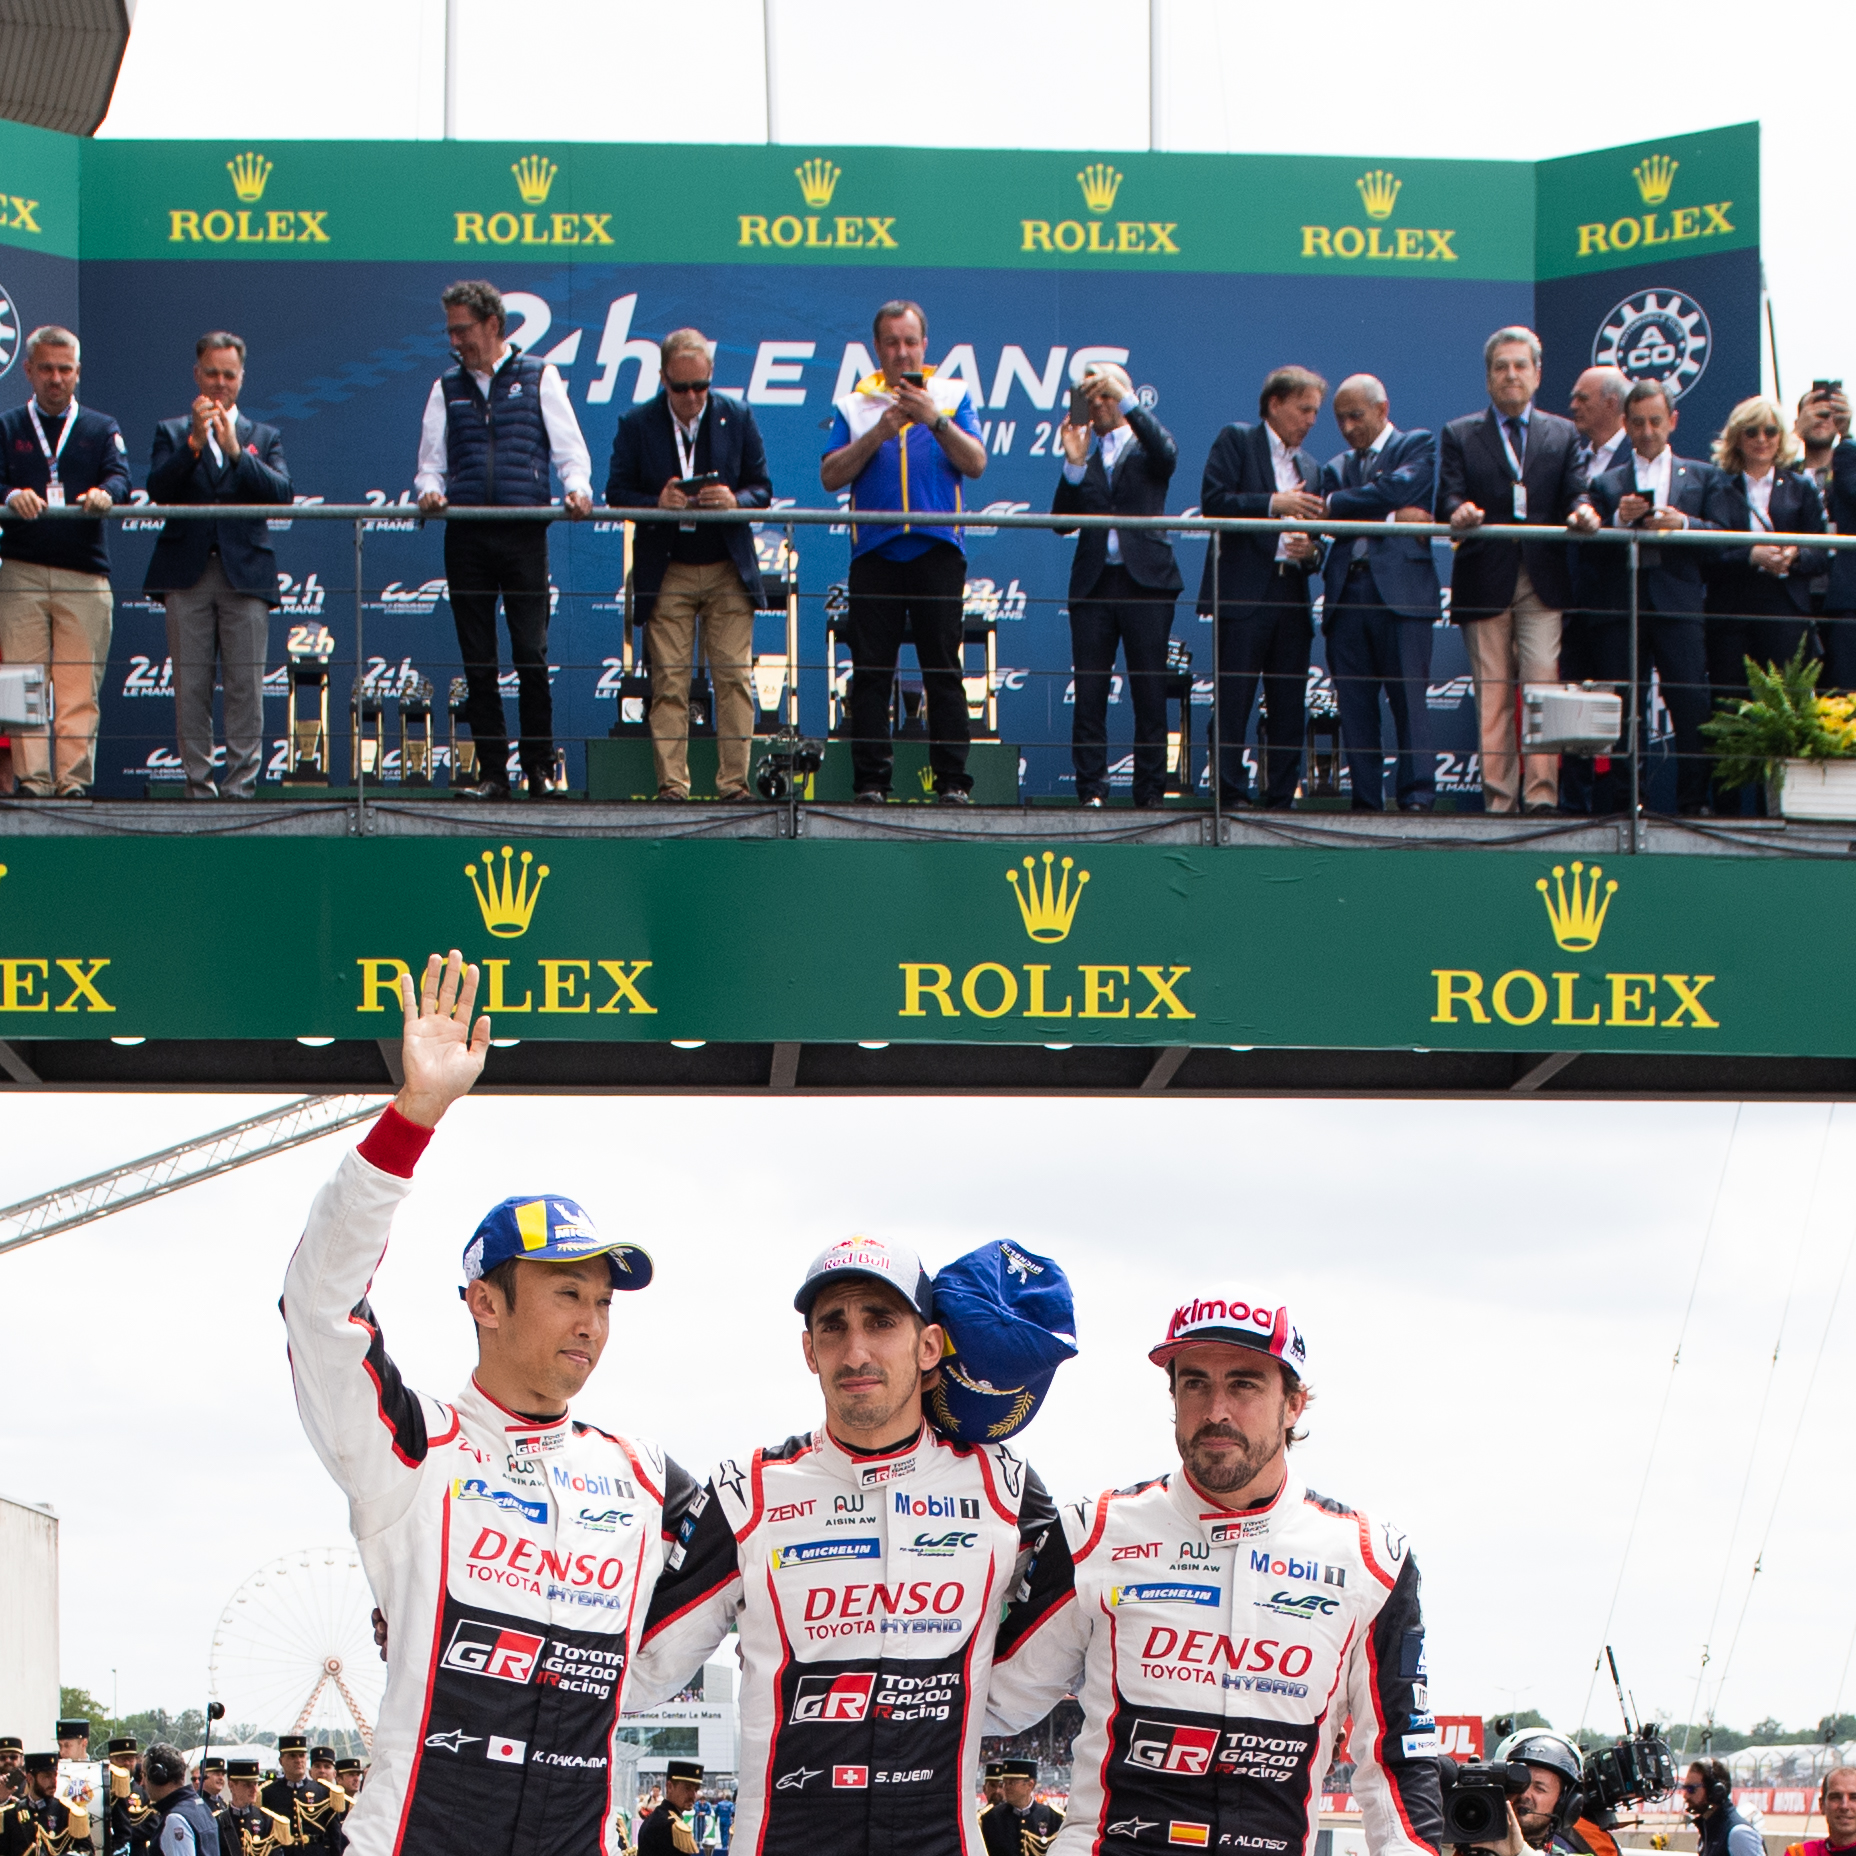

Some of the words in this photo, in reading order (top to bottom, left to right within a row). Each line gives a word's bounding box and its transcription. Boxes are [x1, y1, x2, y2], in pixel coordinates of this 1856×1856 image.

[168, 210, 329, 242] ROLEX
[454, 212, 613, 246] ROLEX
[738, 214, 897, 250] ROLEX
[1021, 219, 1180, 254] ROLEX
[1576, 201, 1735, 258] ROLEX
[1301, 225, 1457, 261] ROLEX
[898, 961, 1195, 1021] ROLEX
[1430, 967, 1719, 1030] ROLEX
[824, 1253, 852, 1270] Red
[858, 1252, 891, 1270] Bull
[1001, 1242, 1044, 1274] MICHELIN
[1176, 1298, 1272, 1330] kimoa
[554, 1467, 611, 1496] Mobil
[862, 1467, 891, 1485] GR
[580, 1508, 634, 1527] WEC
[895, 1492, 955, 1518] Mobil
[825, 1517, 855, 1527] AISIN
[857, 1516, 877, 1524] AW
[1211, 1528, 1241, 1541] GR
[801, 1543, 871, 1560] MICHELIN
[914, 1532, 979, 1548] WEC
[469, 1527, 624, 1591] DENSO
[1169, 1563, 1200, 1572] AISIN
[1203, 1565, 1221, 1573] AW
[1251, 1550, 1318, 1582] Mobil
[467, 1565, 541, 1596] TOYOTA
[804, 1581, 965, 1622] DENSO
[1141, 1589, 1213, 1601] MICHELIN
[1272, 1591, 1340, 1616] WEC
[804, 1620, 876, 1641] TOYOTA
[882, 1618, 962, 1634] HYBRID
[447, 1640, 535, 1680] GR
[551, 1642, 625, 1667] TOYOTA
[1141, 1626, 1313, 1677] DENSO
[546, 1659, 618, 1681] GAZOO
[881, 1673, 960, 1690] TOYOTA
[1141, 1663, 1217, 1686] TOYOTA
[1226, 1675, 1308, 1698] HYBRID
[538, 1671, 611, 1700] Racing
[876, 1689, 952, 1705] GAZOO
[794, 1692, 871, 1720] GR
[872, 1705, 950, 1721] Racing
[1227, 1733, 1307, 1752] TOYOTA
[1132, 1741, 1214, 1773] GR
[1218, 1749, 1299, 1768] GAZOO
[1215, 1764, 1293, 1782] Racing
[1234, 1835, 1288, 1851] ALONSO
